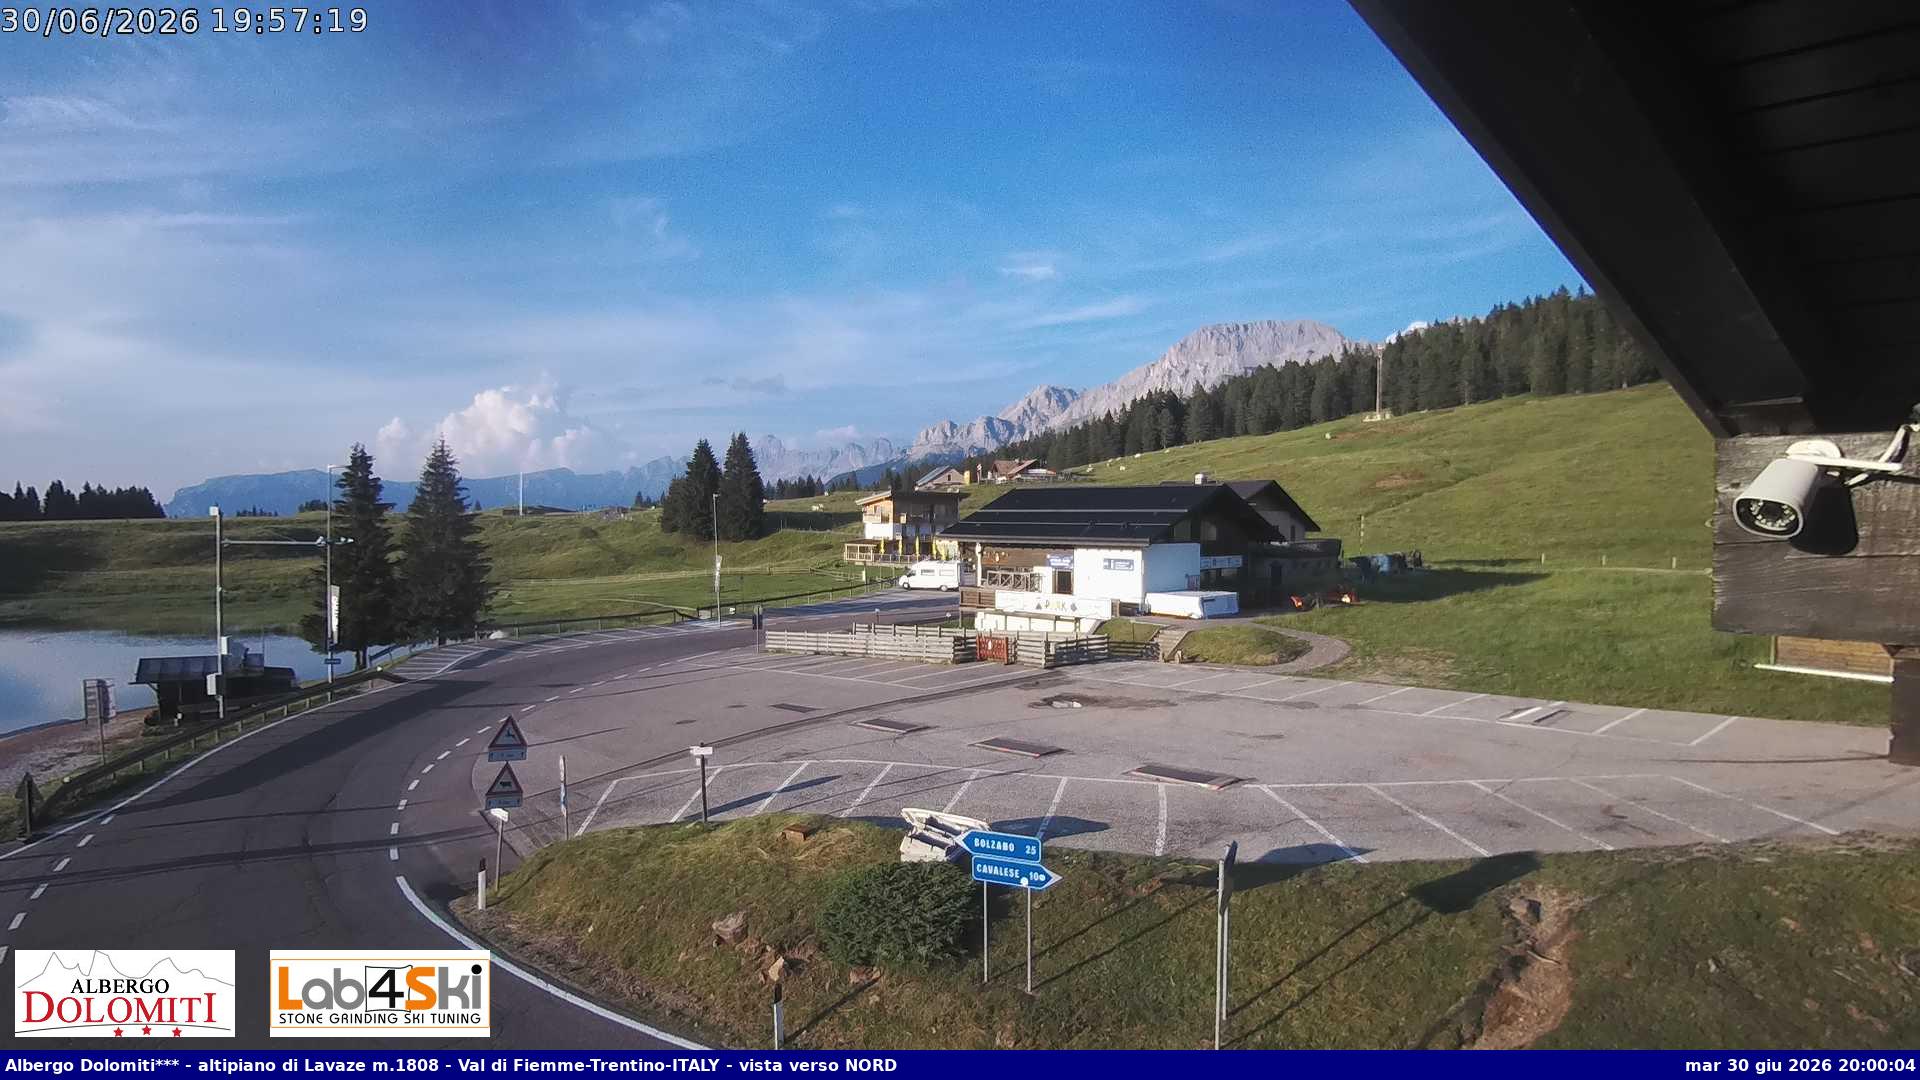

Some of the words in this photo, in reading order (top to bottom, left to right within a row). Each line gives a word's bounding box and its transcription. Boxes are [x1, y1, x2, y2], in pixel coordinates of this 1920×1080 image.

[974, 838, 1015, 852] BOLZANO
[1025, 845, 1037, 855] 25
[976, 864, 1020, 879] CAVALESE
